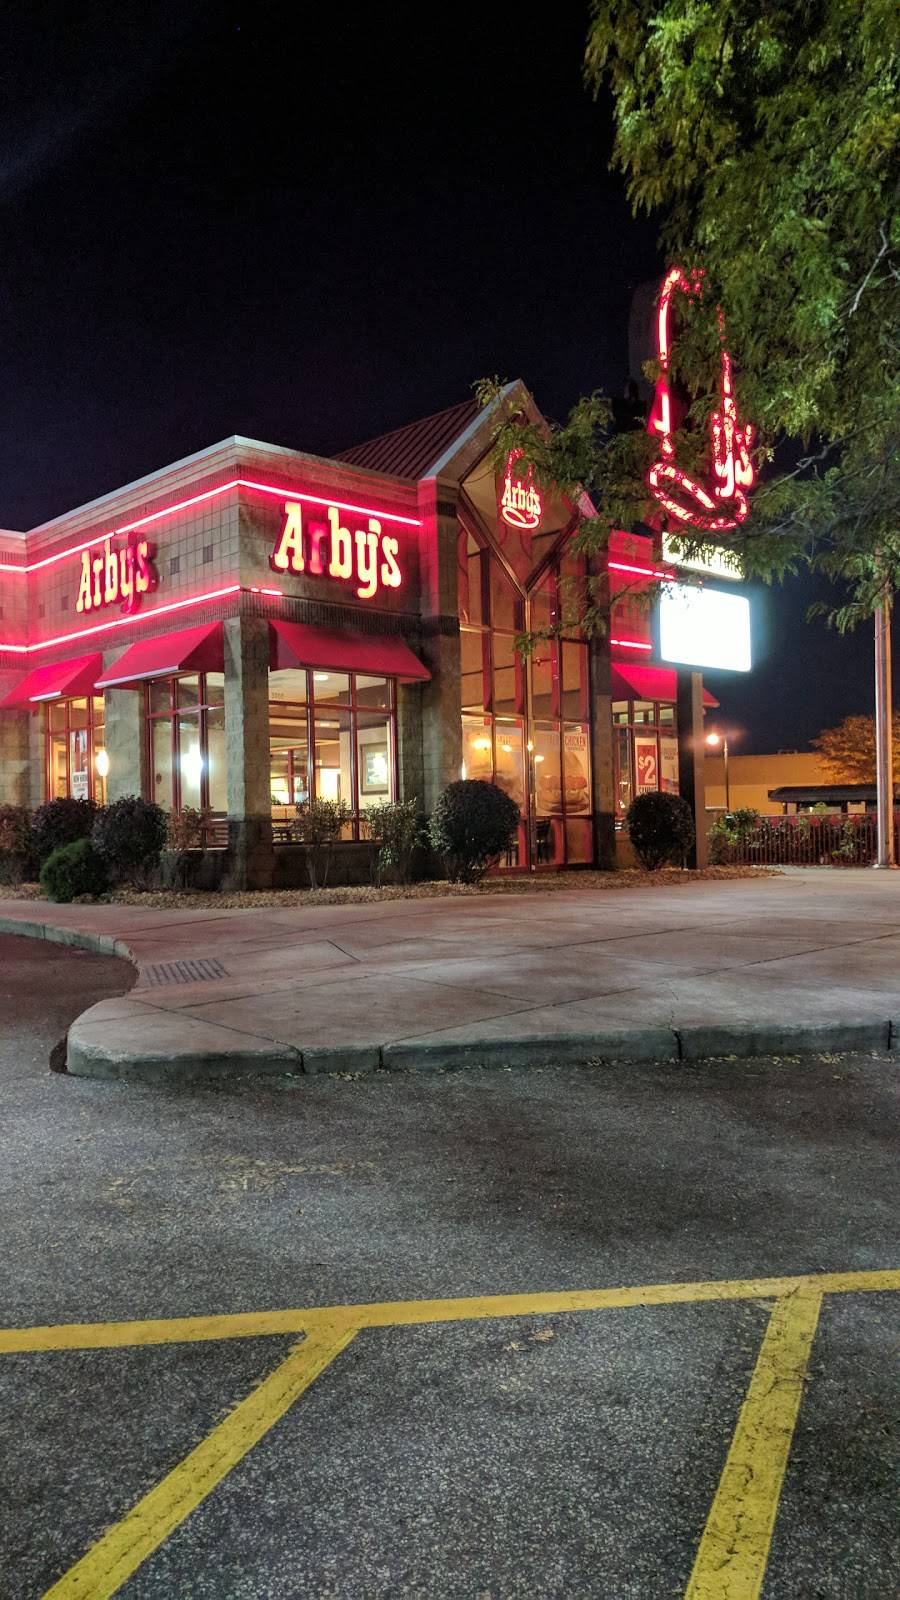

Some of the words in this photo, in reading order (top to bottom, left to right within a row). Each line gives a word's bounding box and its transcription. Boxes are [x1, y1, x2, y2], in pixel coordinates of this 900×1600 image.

[501, 477, 542, 519] Arby's
[75, 533, 151, 613] Arby's
[273, 500, 402, 599] Arby's
[638, 755, 656, 784] $2
